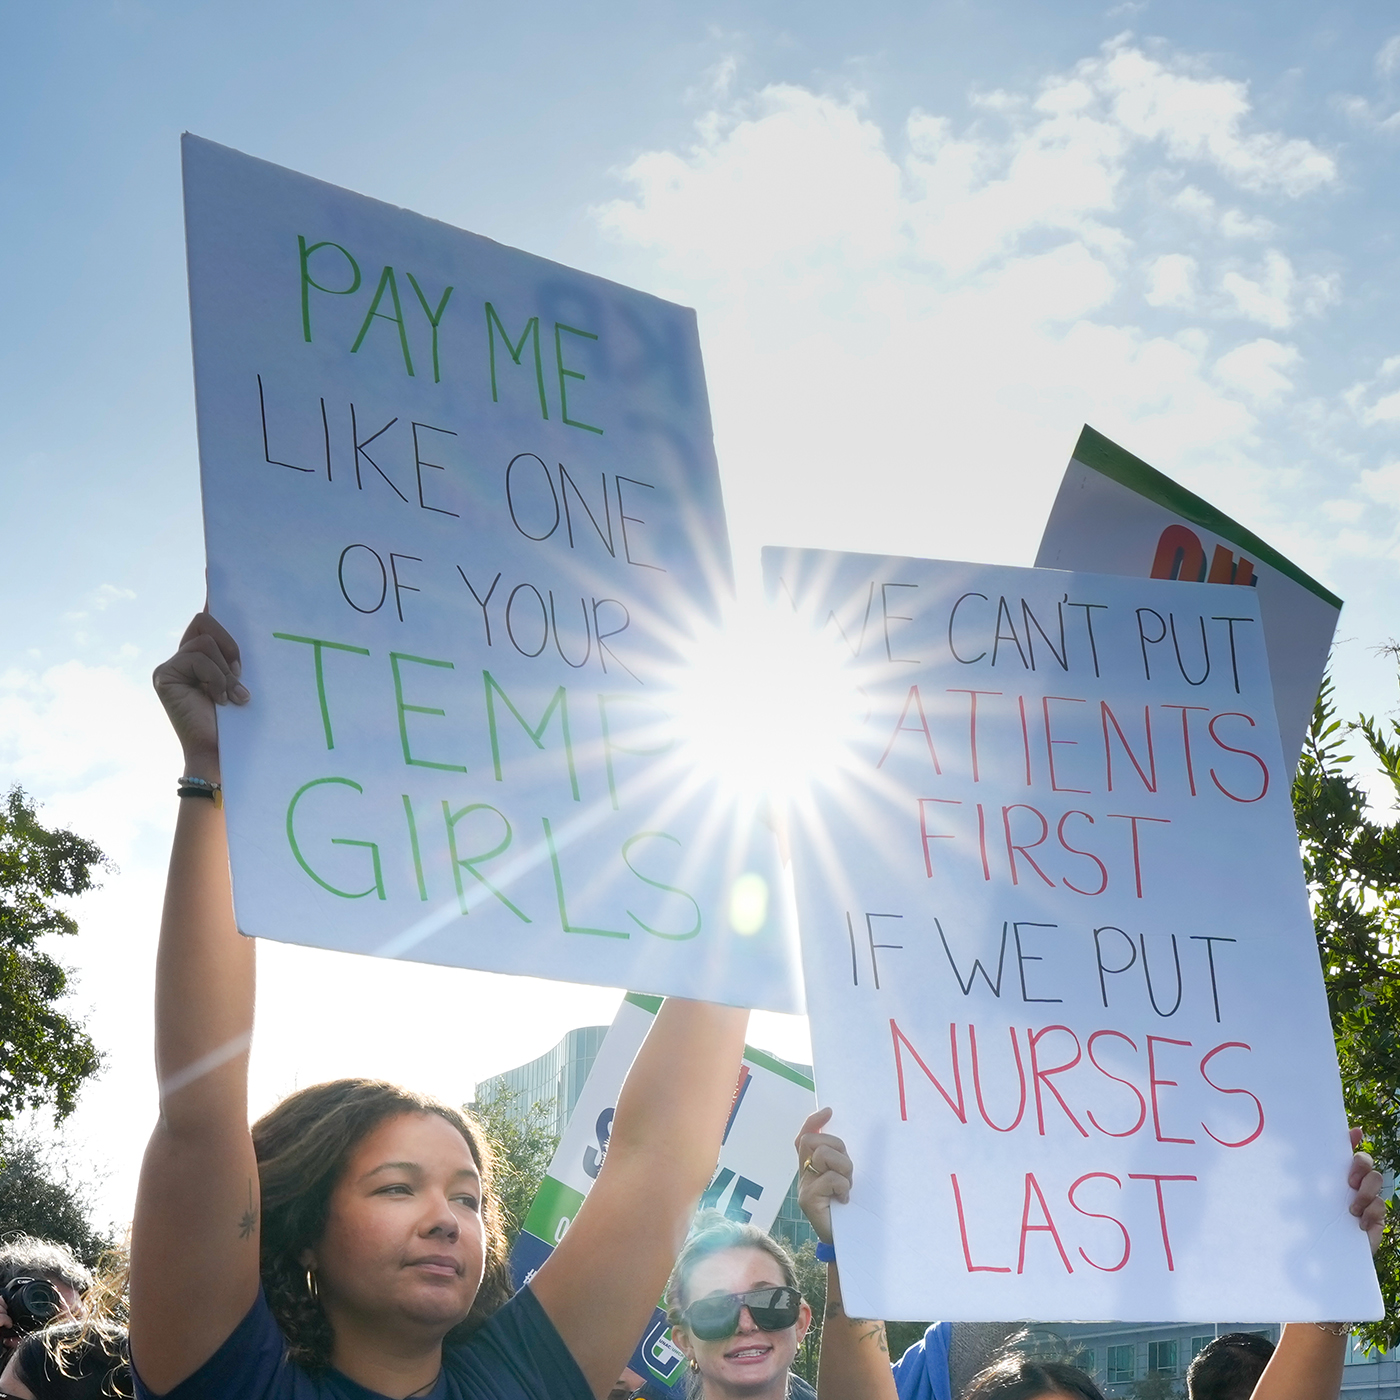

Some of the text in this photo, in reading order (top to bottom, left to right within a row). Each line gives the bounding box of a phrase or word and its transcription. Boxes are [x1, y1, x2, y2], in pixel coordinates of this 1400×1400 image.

[297, 235, 605, 436] PAY ME
[257, 373, 668, 573] LIKE ONE
[338, 543, 645, 685] OF YOUR
[947, 590, 1109, 681] CAN'T
[1135, 607, 1256, 694] PUT
[272, 631, 680, 811] TEMP
[865, 684, 1272, 804] ATIENTS
[286, 776, 703, 943] GIRLS
[917, 796, 1172, 900] FIRST
[846, 910, 1238, 1023] IF WE PUT
[889, 1017, 1266, 1149] NURSES
[950, 1170, 1199, 1275] LAST
